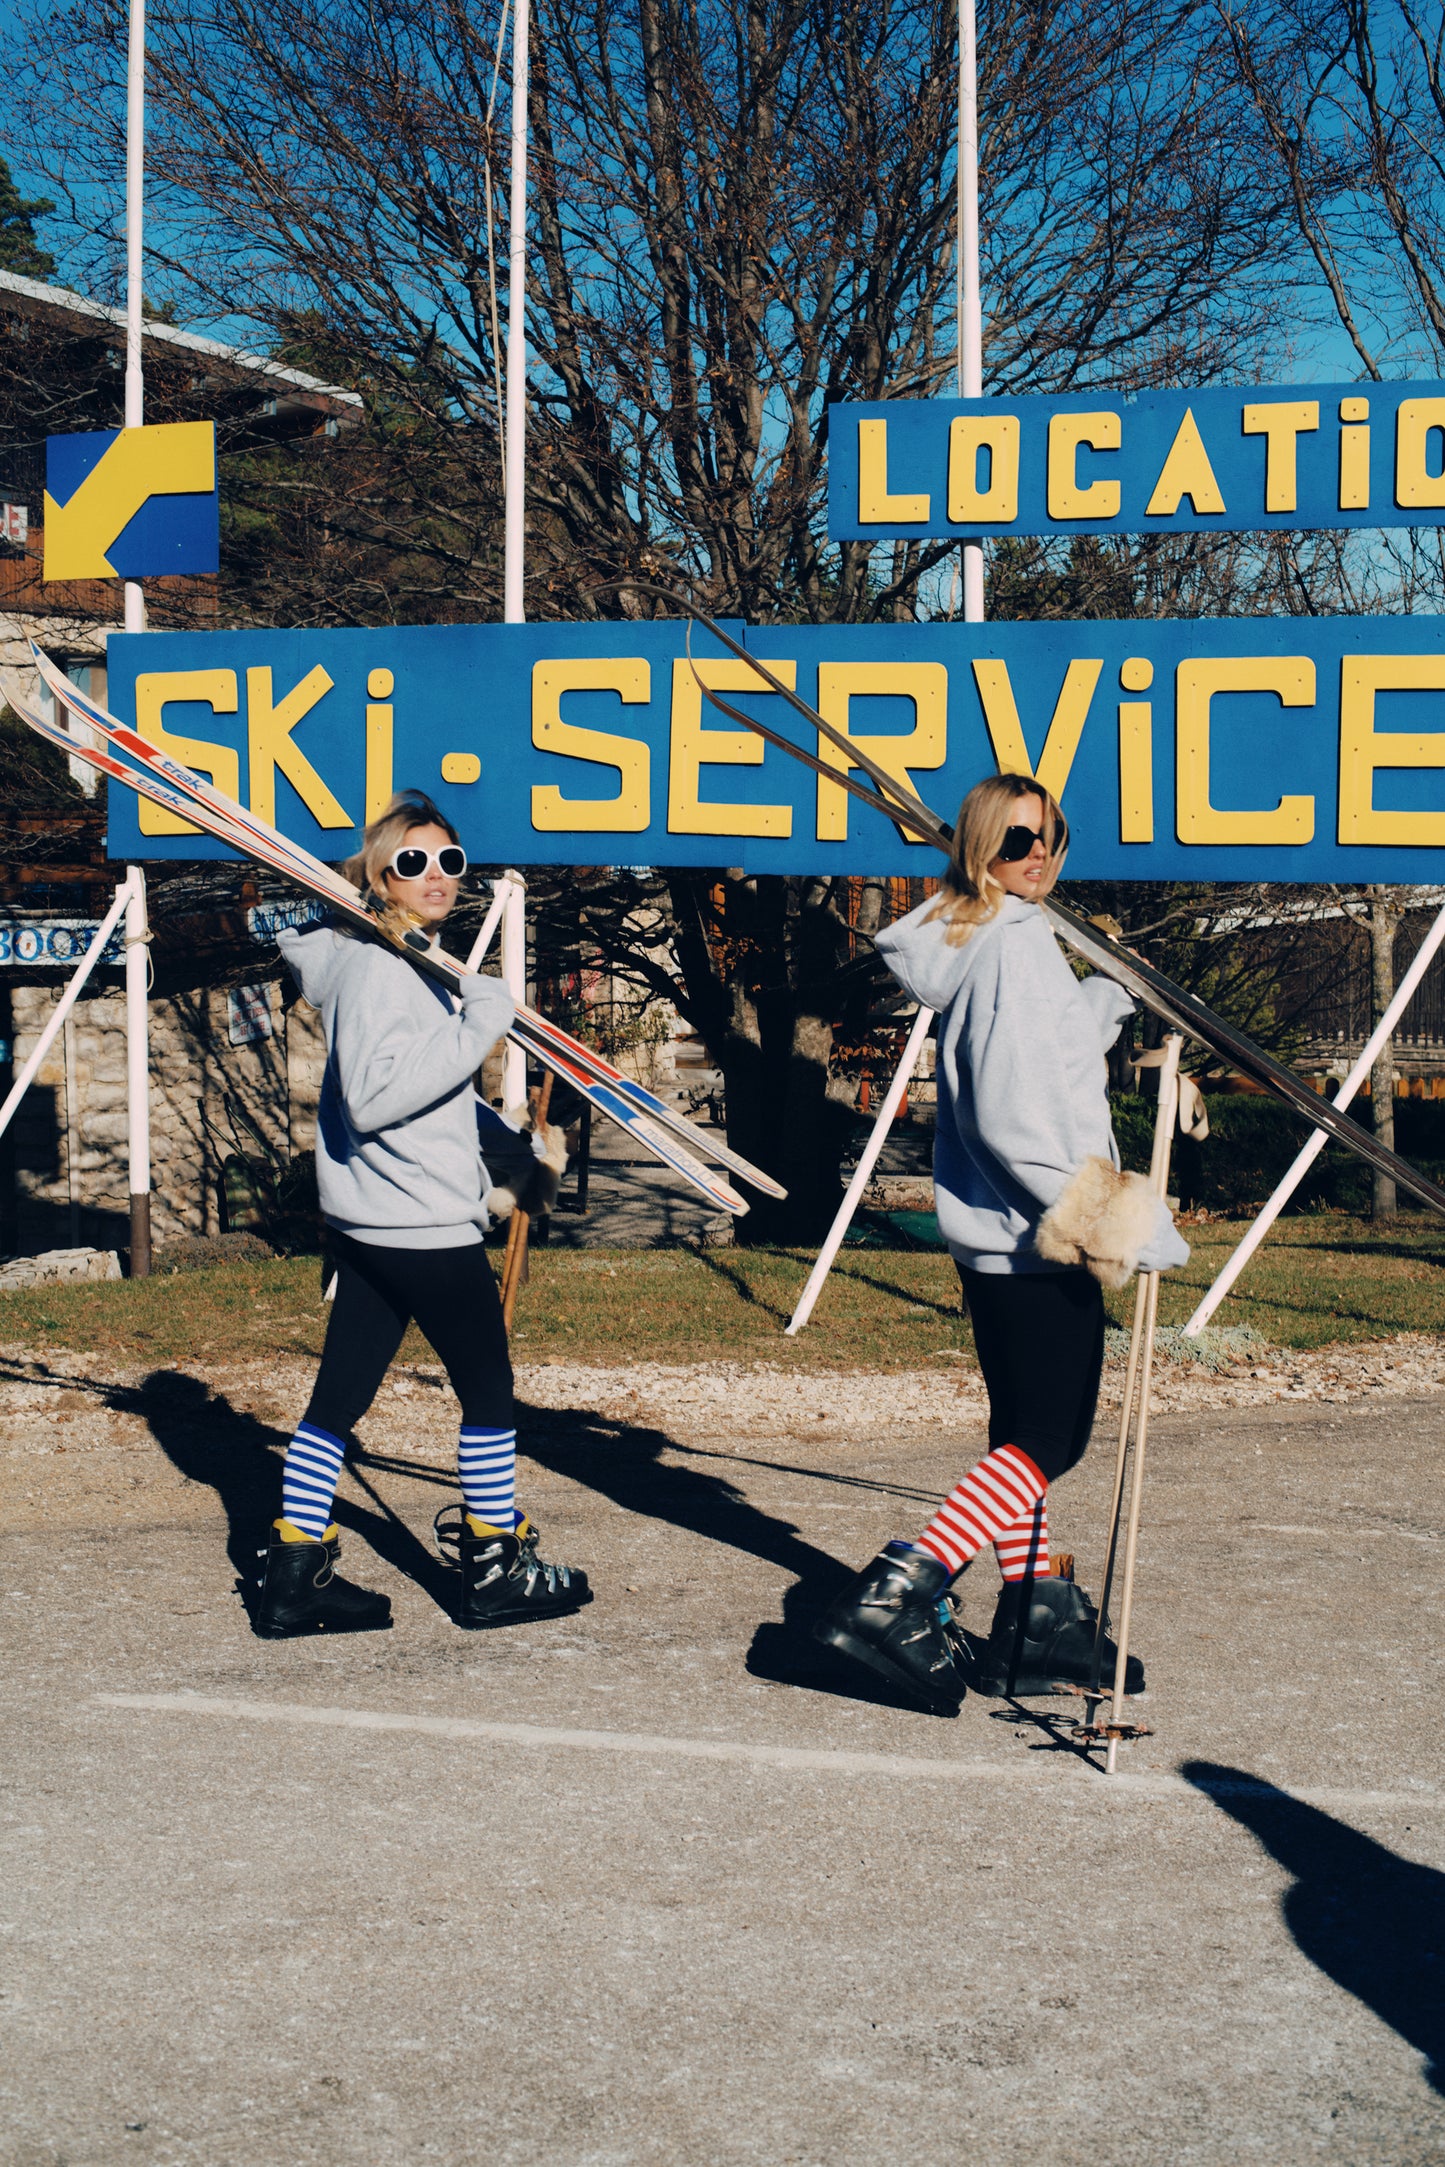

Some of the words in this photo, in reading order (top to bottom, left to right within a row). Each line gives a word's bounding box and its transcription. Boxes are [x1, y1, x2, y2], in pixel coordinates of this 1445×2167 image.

[137, 778, 185, 805] trak
[162, 761, 205, 790] trak
[645, 1128, 700, 1173] marathon
[680, 1120, 734, 1163] marathon
